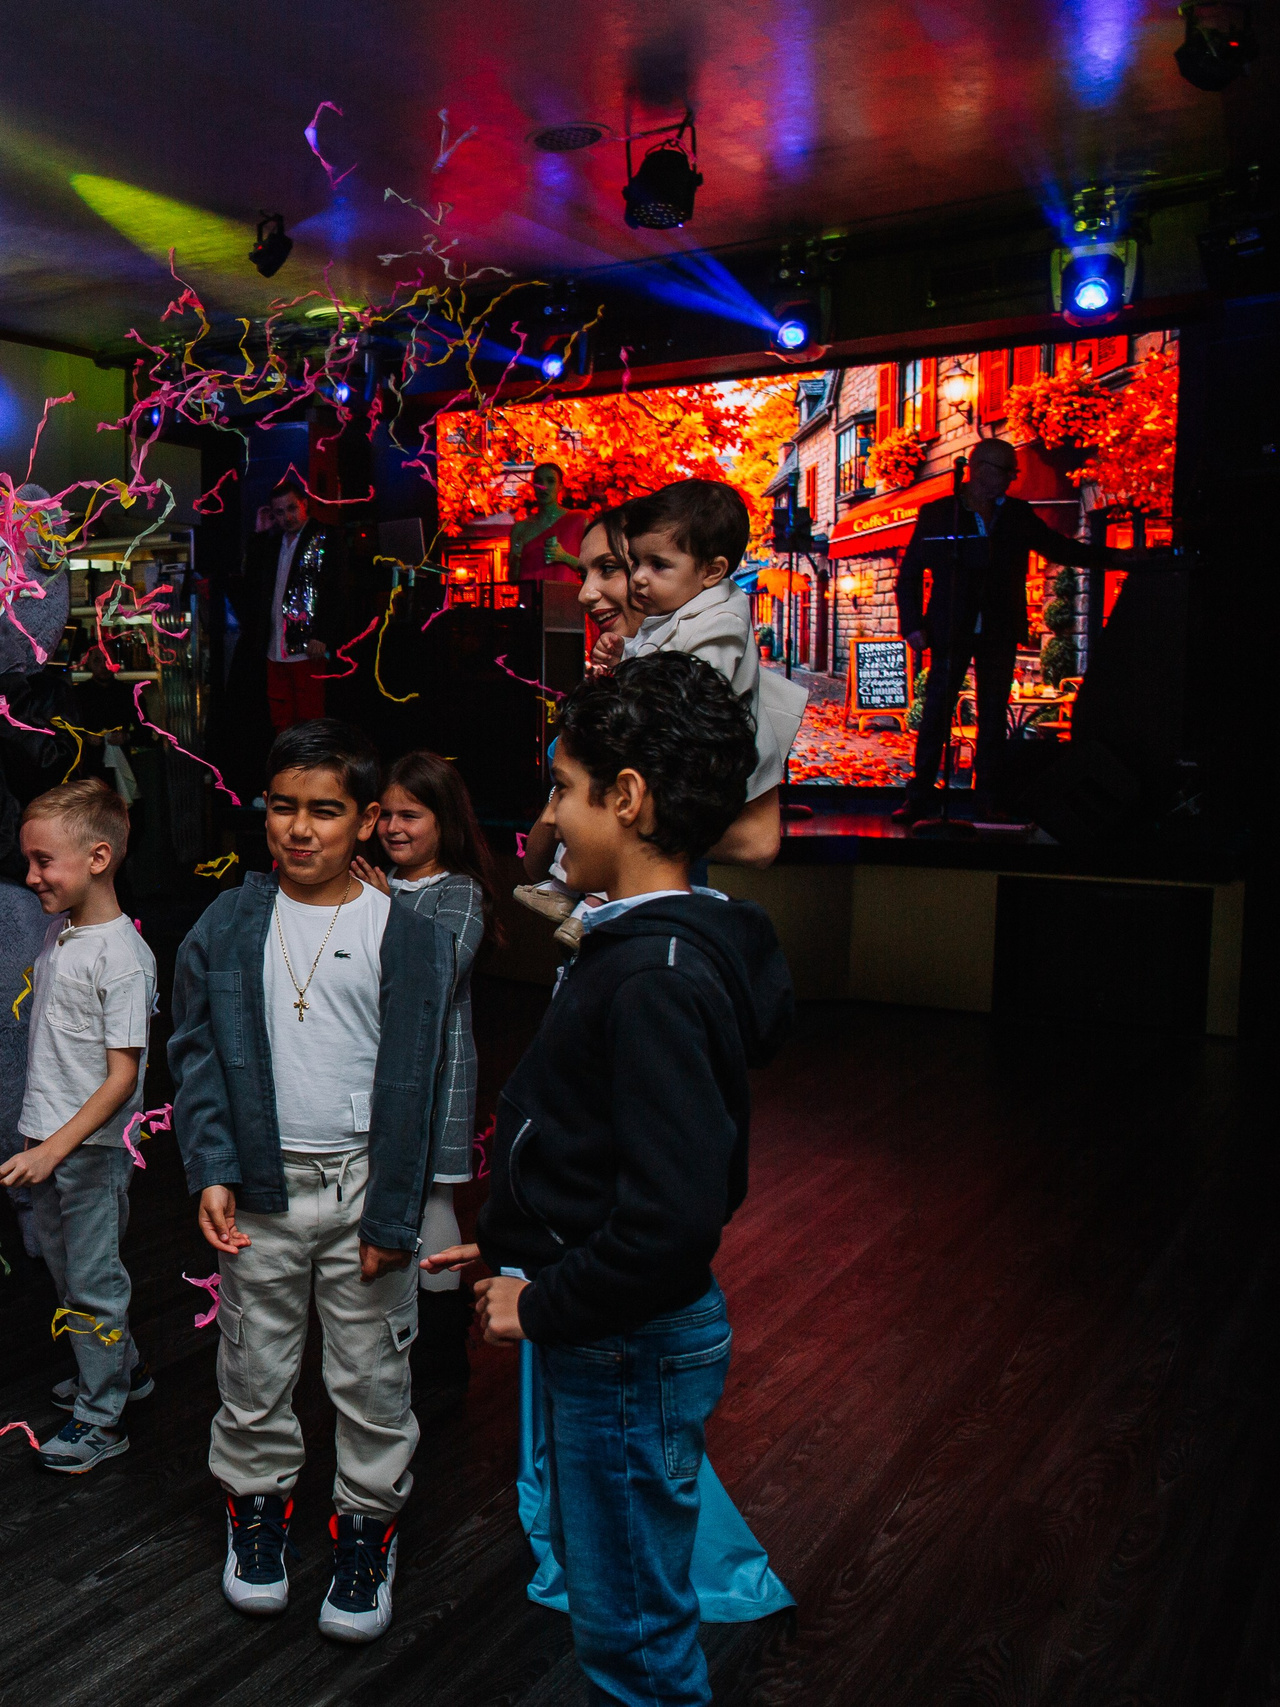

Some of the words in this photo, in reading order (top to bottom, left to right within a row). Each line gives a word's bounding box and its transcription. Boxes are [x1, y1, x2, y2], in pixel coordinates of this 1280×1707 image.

[853, 514, 889, 532] Coffee
[858, 642, 904, 654] ESPRESSO
[84, 1433, 107, 1452] N
